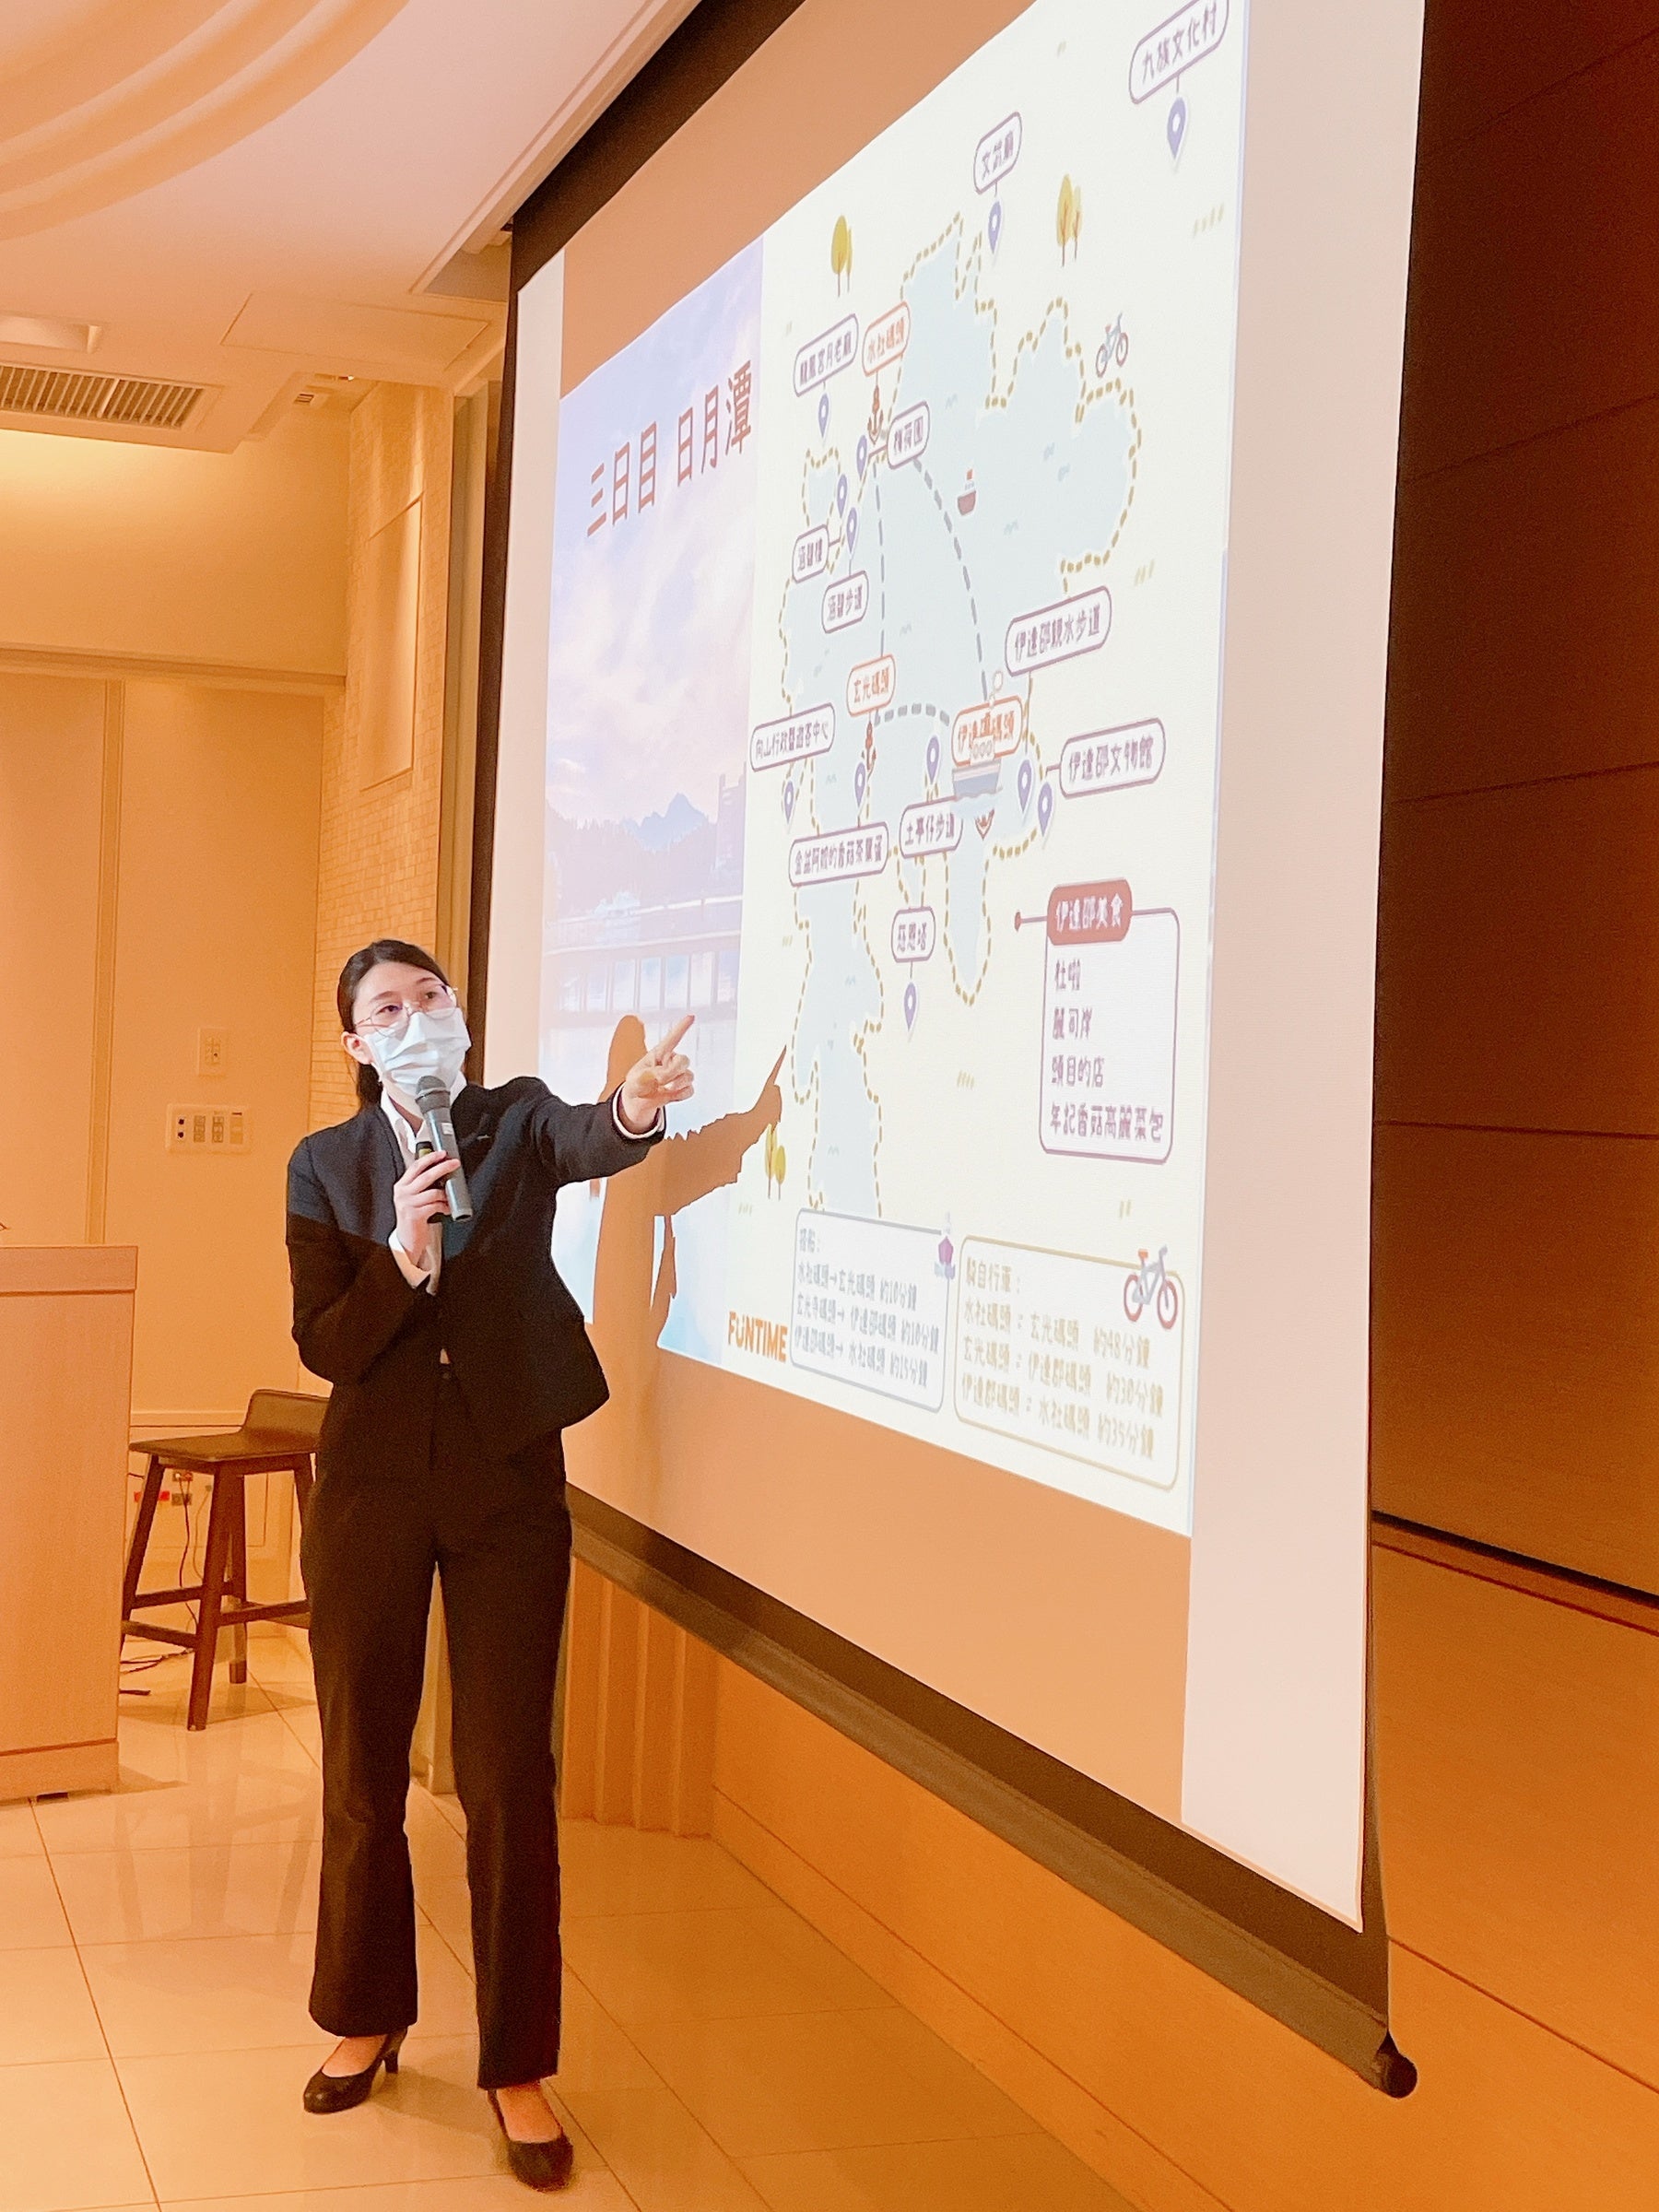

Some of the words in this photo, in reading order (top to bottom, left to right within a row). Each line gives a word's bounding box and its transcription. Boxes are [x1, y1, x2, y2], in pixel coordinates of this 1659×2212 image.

[1142, 0, 1218, 84] 九族文化村
[587, 421, 657, 536] 三日目
[677, 360, 752, 487] 日月潭
[1069, 735, 1154, 782] 伊達邵文物館
[1055, 893, 1124, 933] 伊達邵美食
[1052, 1053, 1106, 1088] 頭目的店
[728, 1311, 788, 1363] FUNTIME
